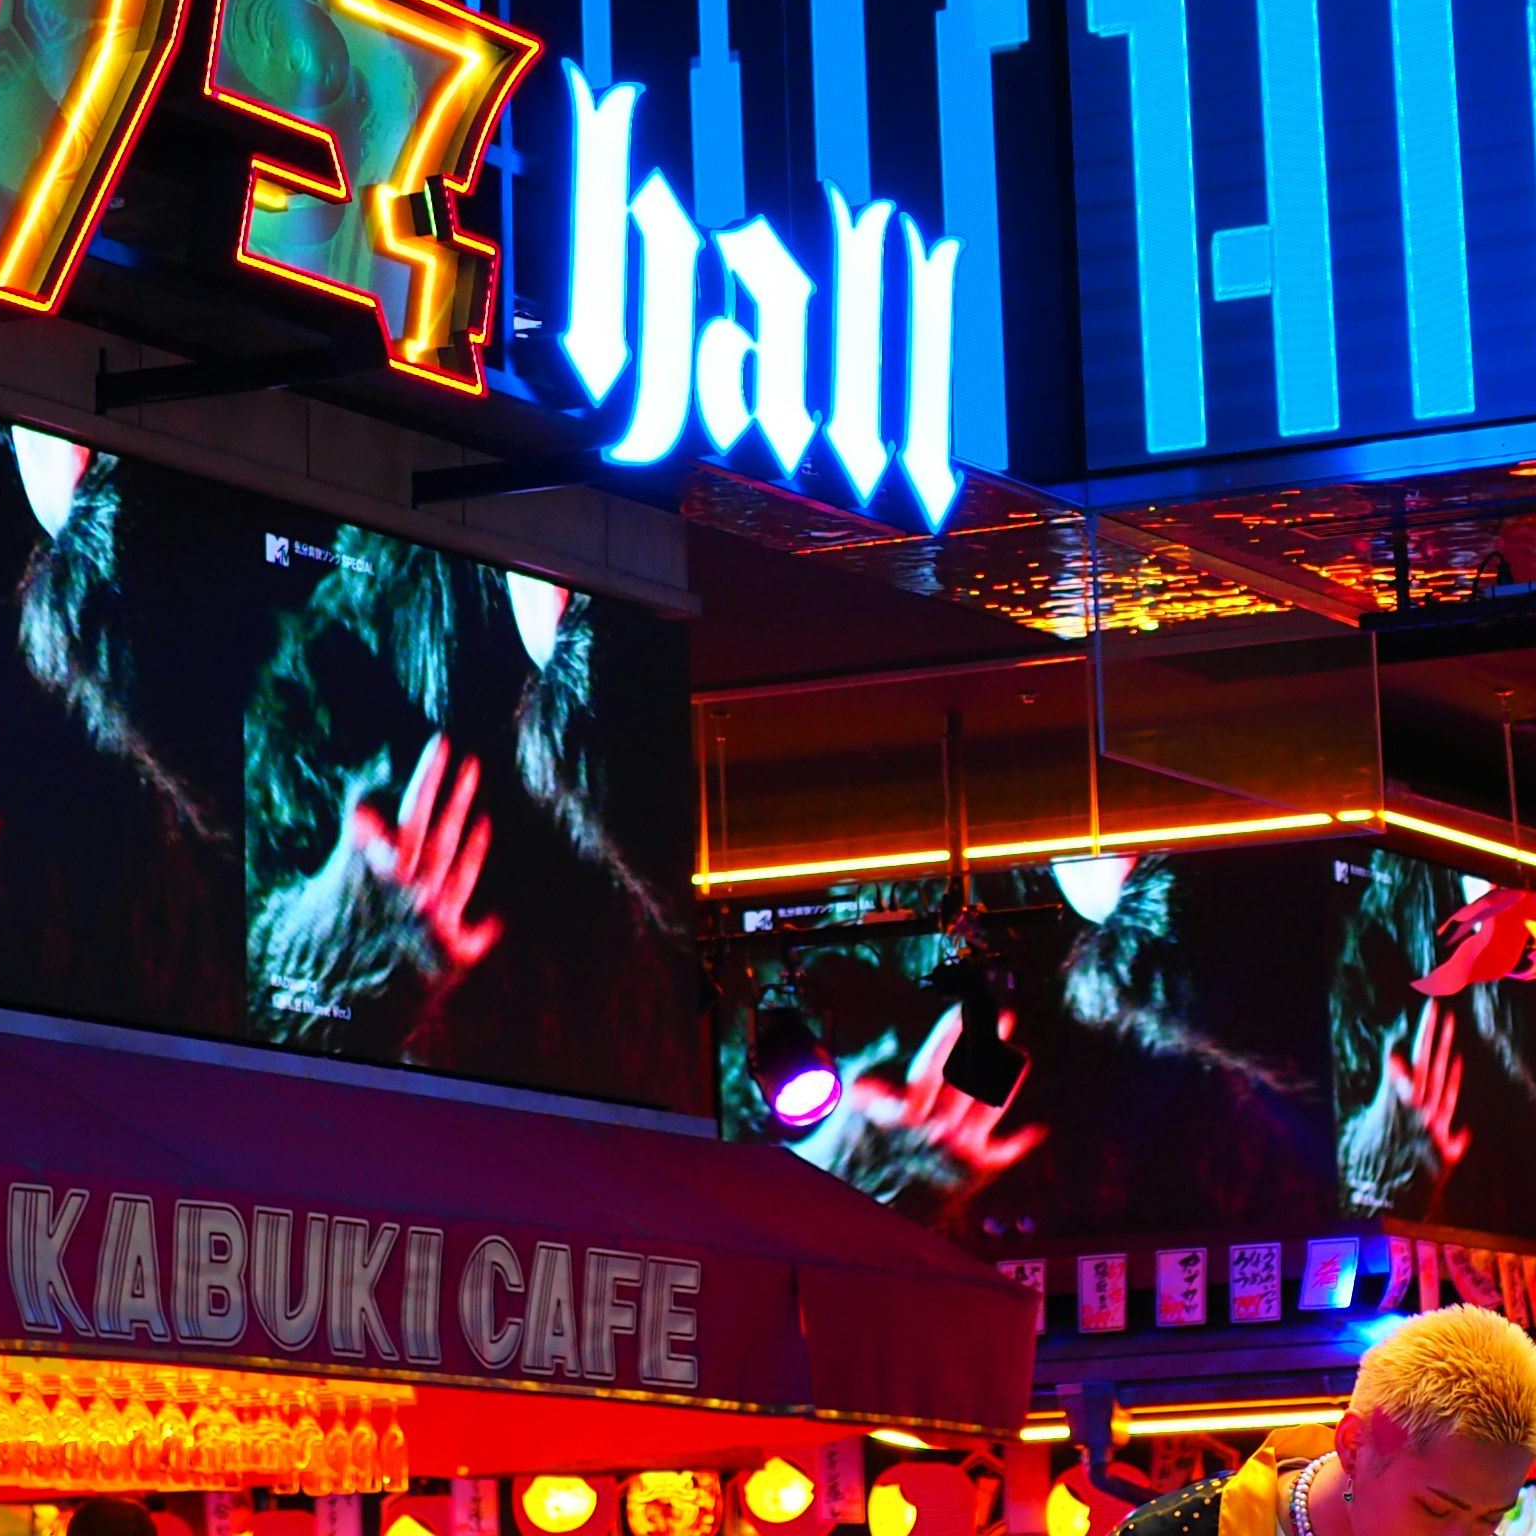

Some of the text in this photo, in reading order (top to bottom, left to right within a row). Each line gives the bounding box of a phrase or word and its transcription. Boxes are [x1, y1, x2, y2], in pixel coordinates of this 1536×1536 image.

[560, 58, 962, 532] hall
[6, 1181, 701, 1389] KABUKI CAFE
